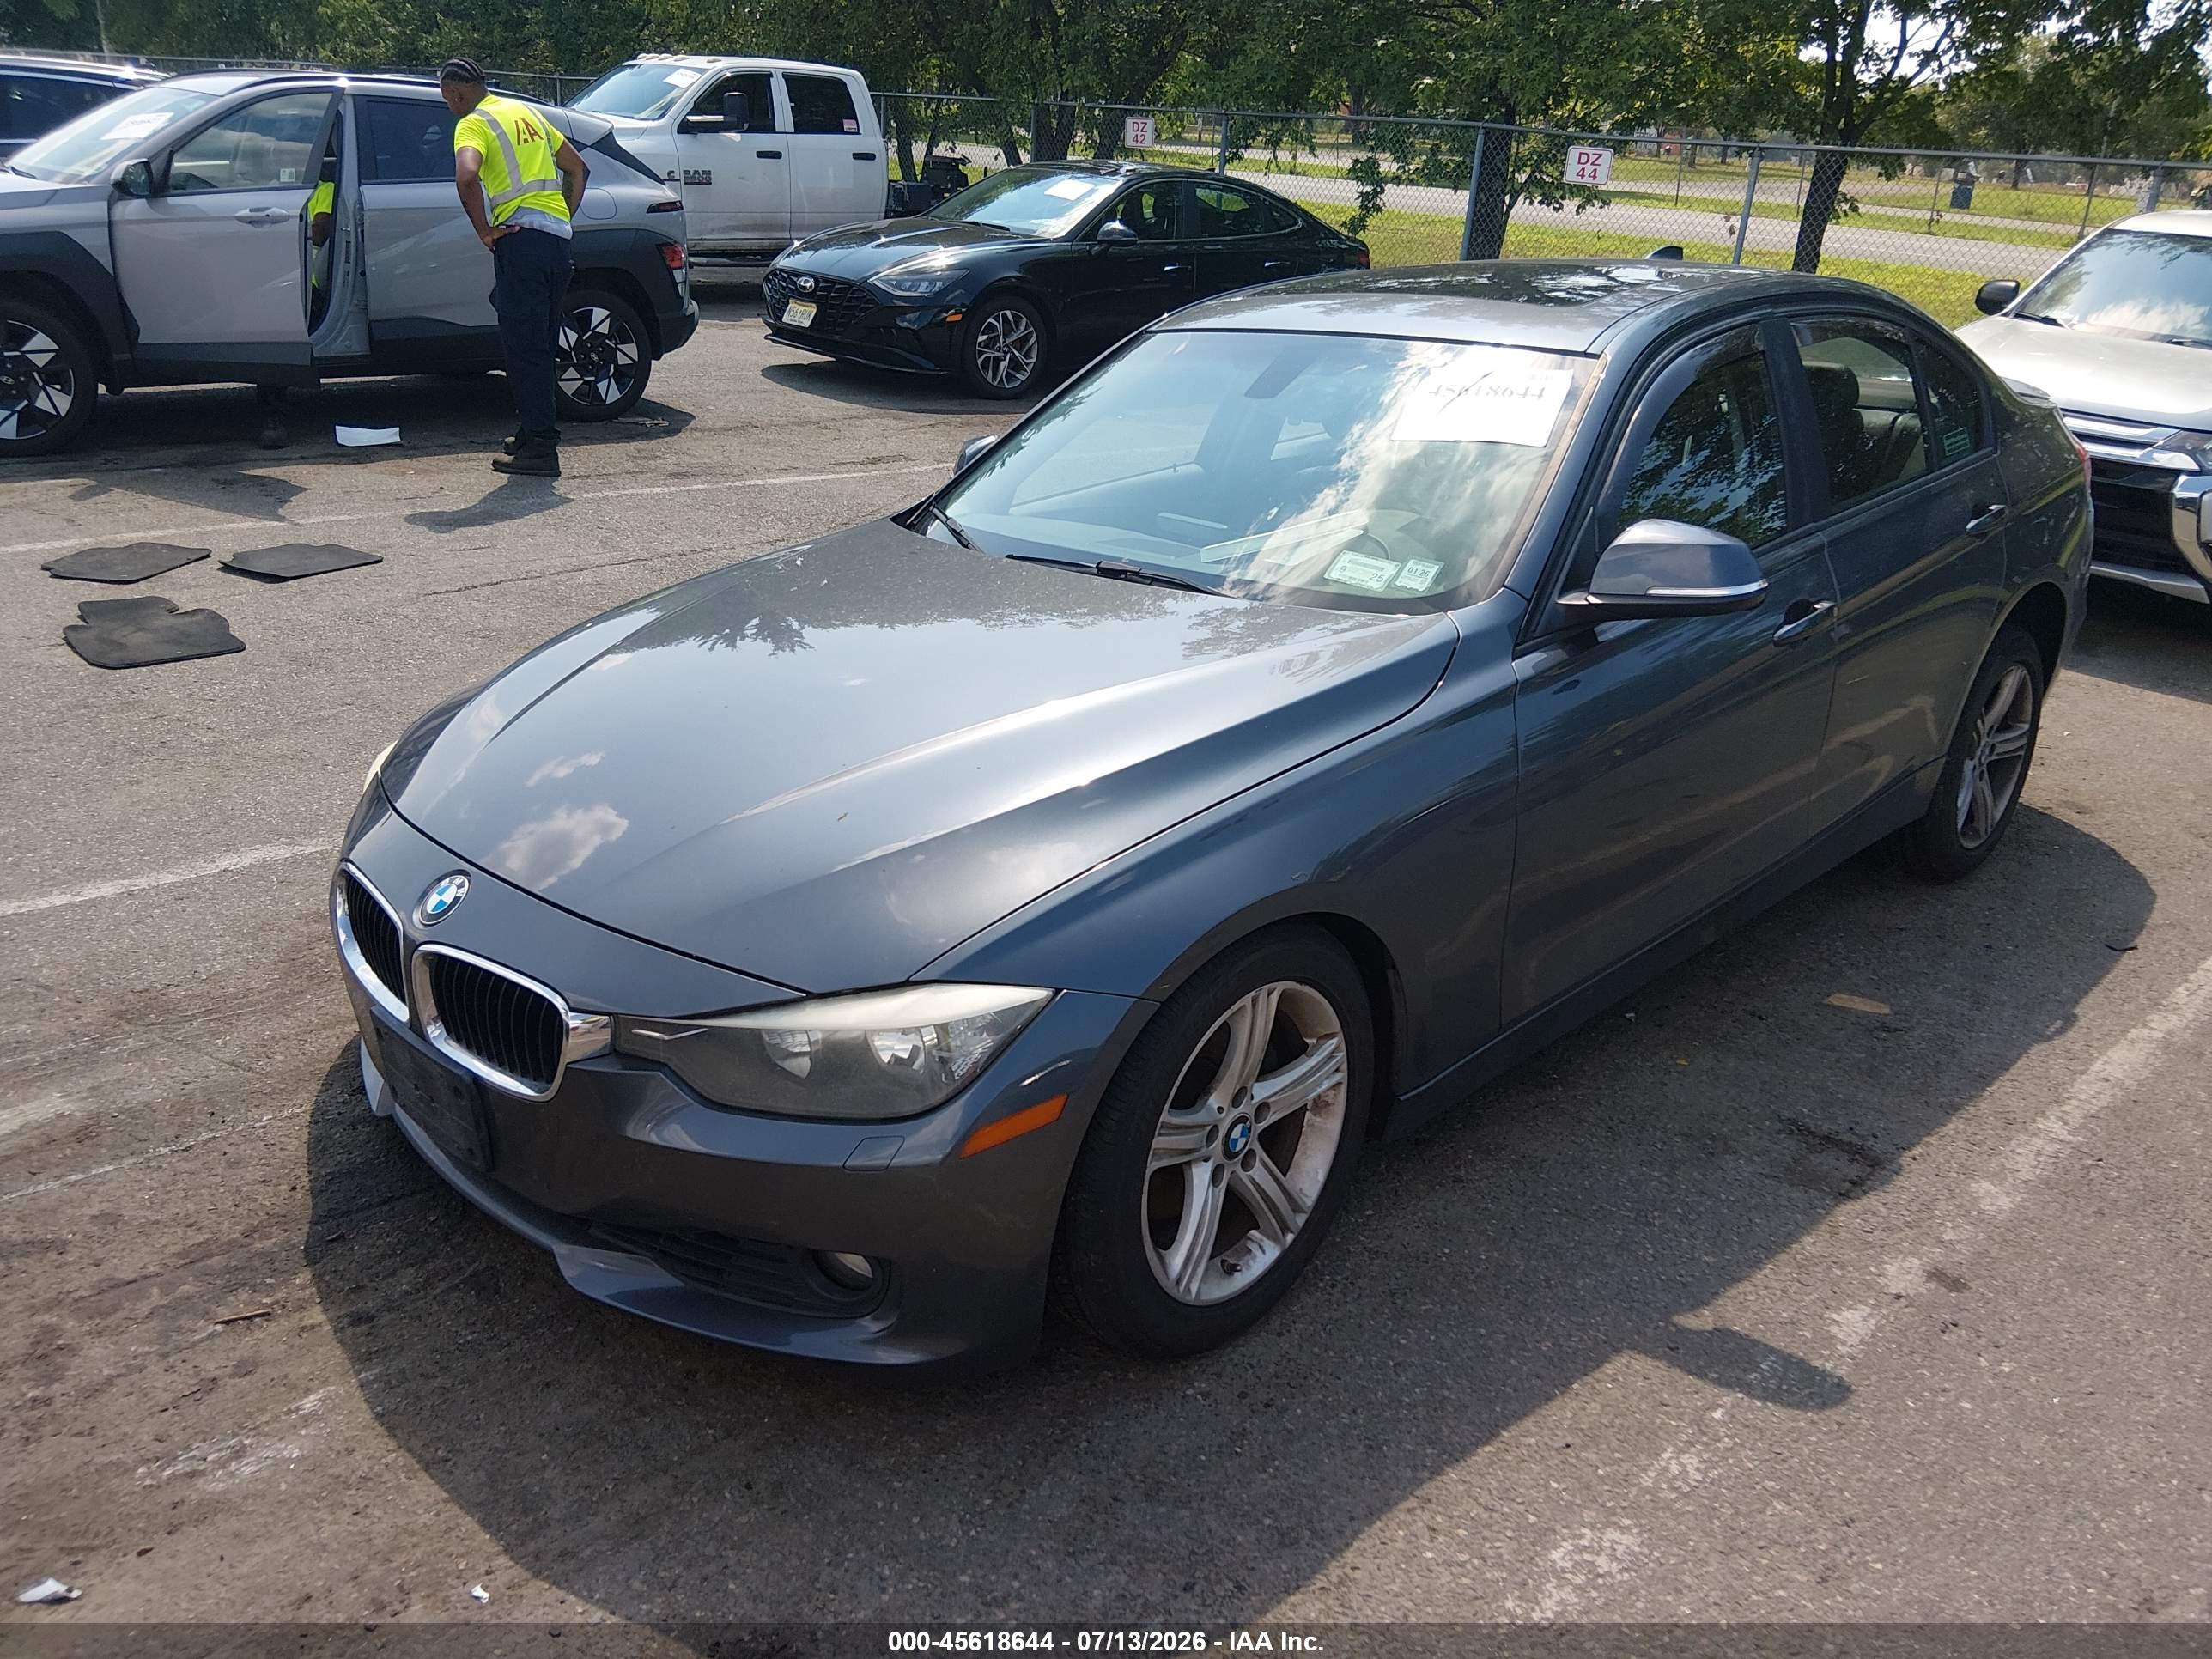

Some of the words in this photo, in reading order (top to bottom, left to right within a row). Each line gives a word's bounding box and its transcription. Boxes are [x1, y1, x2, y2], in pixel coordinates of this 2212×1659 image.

[1132, 121, 1148, 133] DZ
[1132, 133, 1146, 144] 42
[1577, 151, 1603, 167] DZ
[1576, 167, 1598, 180] 44
[1339, 565, 1347, 574] 9
[1369, 572, 1385, 583] 25
